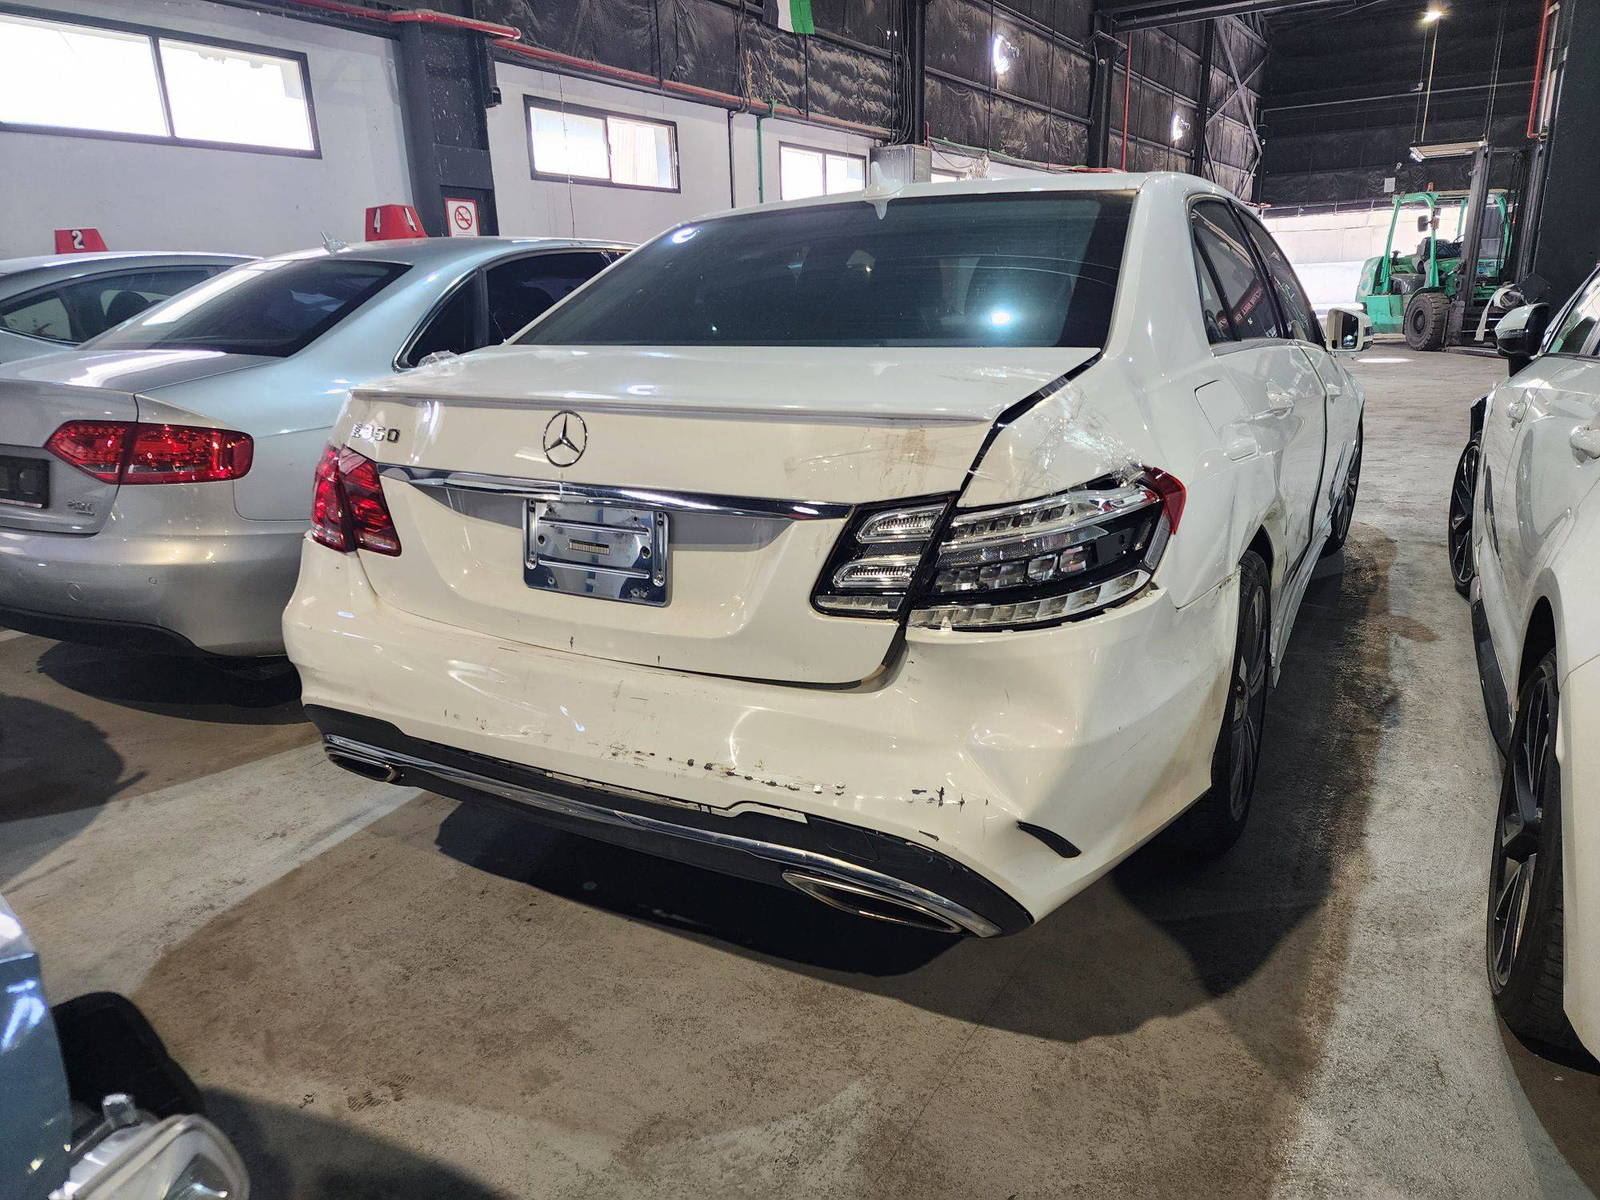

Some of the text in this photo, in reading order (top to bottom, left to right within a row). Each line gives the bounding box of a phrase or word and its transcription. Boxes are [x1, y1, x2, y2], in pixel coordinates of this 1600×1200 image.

[373, 207, 380, 233] 4
[403, 207, 417, 232] 4
[71, 230, 85, 250] 2
